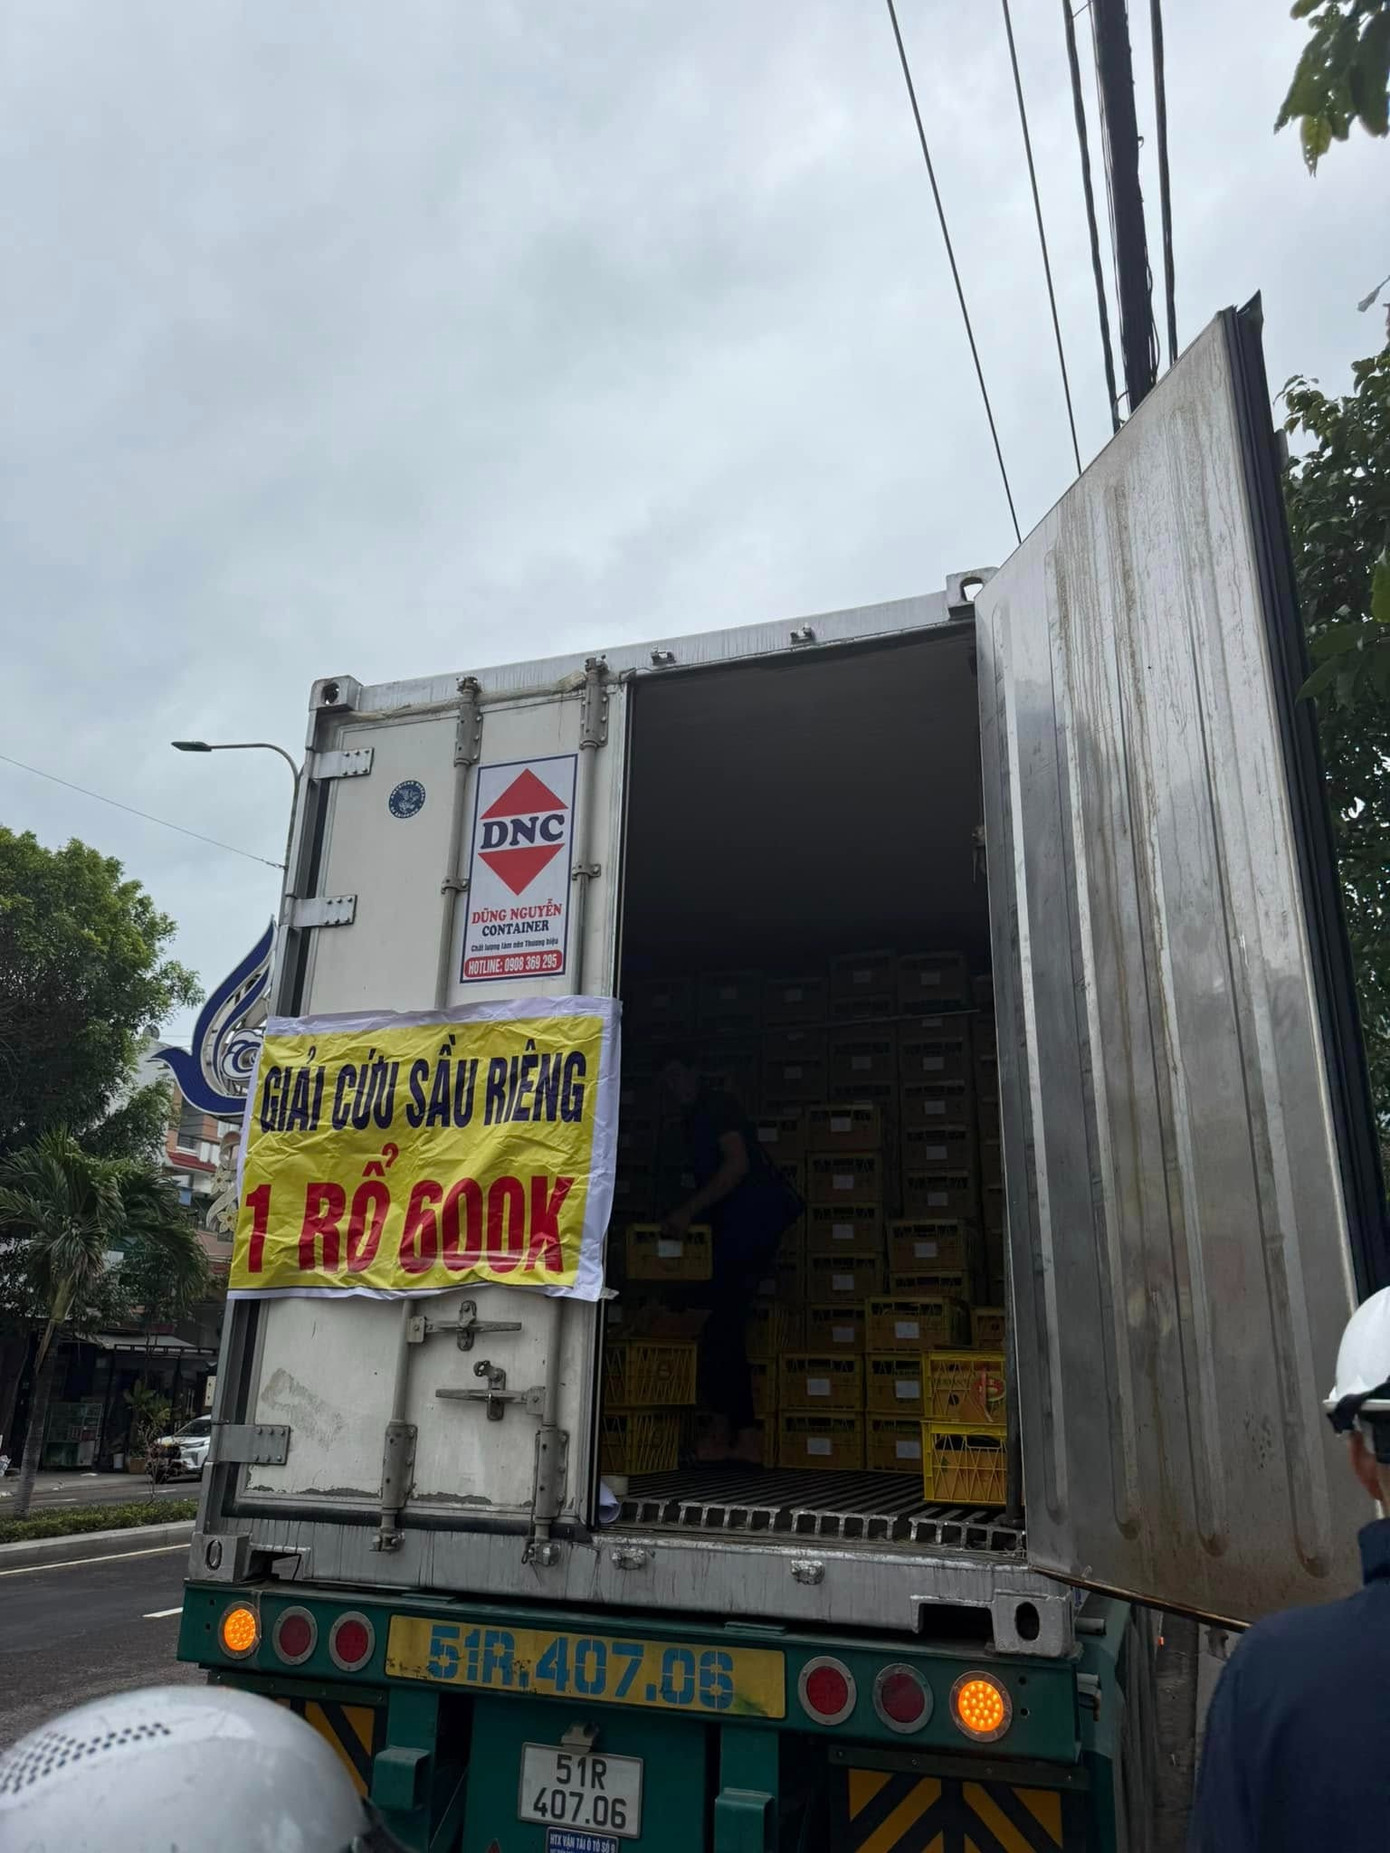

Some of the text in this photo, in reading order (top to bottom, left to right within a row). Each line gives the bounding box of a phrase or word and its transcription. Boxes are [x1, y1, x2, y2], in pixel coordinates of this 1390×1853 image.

[480, 814, 565, 850] DNC
[471, 898, 562, 924] DŨNG NGUYỄN
[482, 920, 549, 937] CONTAINER
[468, 958, 503, 975] HOTLINE:
[504, 956, 524, 972] 0908
[260, 1034, 587, 1134] GIẢI CỨU SẦU RIÊNG
[245, 1142, 575, 1275] 1 RỔ 600K
[556, 1753, 607, 1790] 51R
[533, 1787, 627, 1830] 407.06
